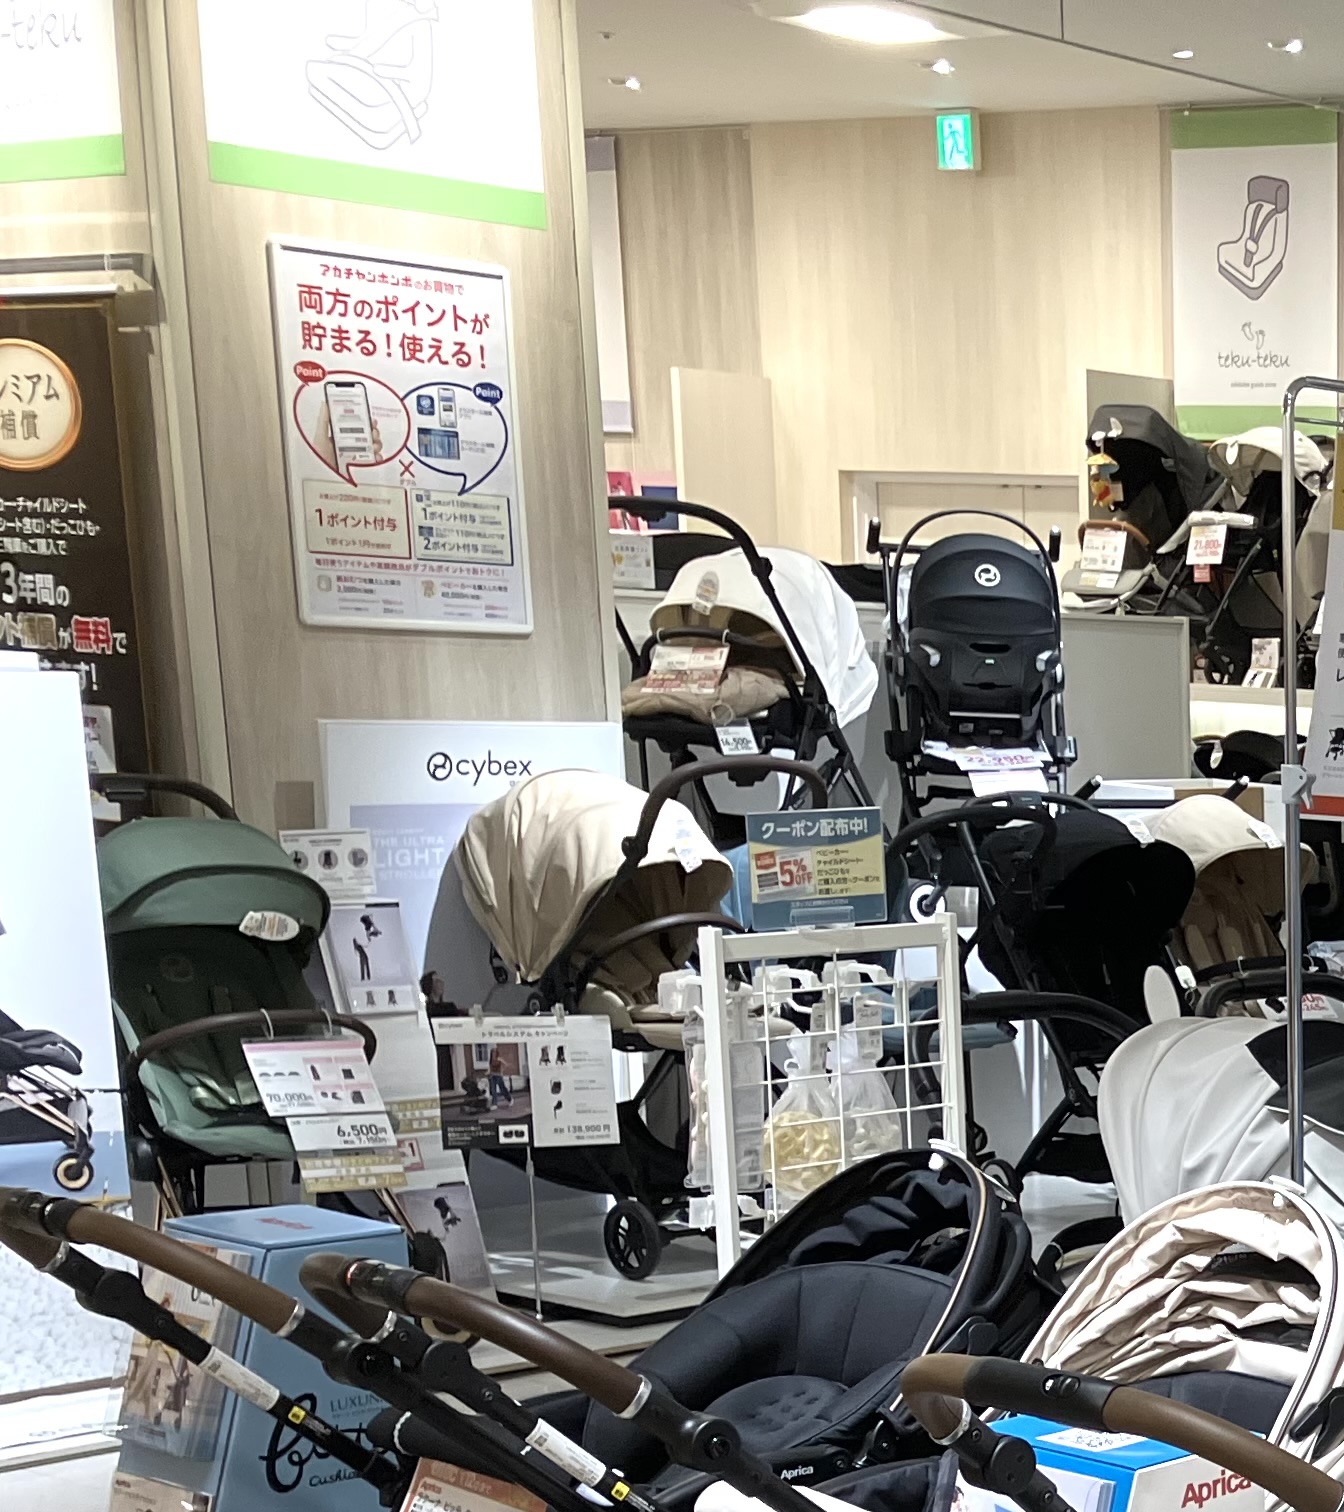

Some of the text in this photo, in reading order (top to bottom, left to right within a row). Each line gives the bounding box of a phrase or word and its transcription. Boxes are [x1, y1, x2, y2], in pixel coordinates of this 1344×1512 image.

[297, 283, 490, 335] 両方のポイントが
[1218, 350, 1291, 369] teku-teku
[296, 365, 323, 378] Point
[476, 387, 500, 399] Point
[315, 508, 398, 532] 1ポイント付与
[456, 750, 533, 786] cybex
[781, 1465, 814, 1481] Aprica
[1180, 1469, 1252, 1510] Aprica
